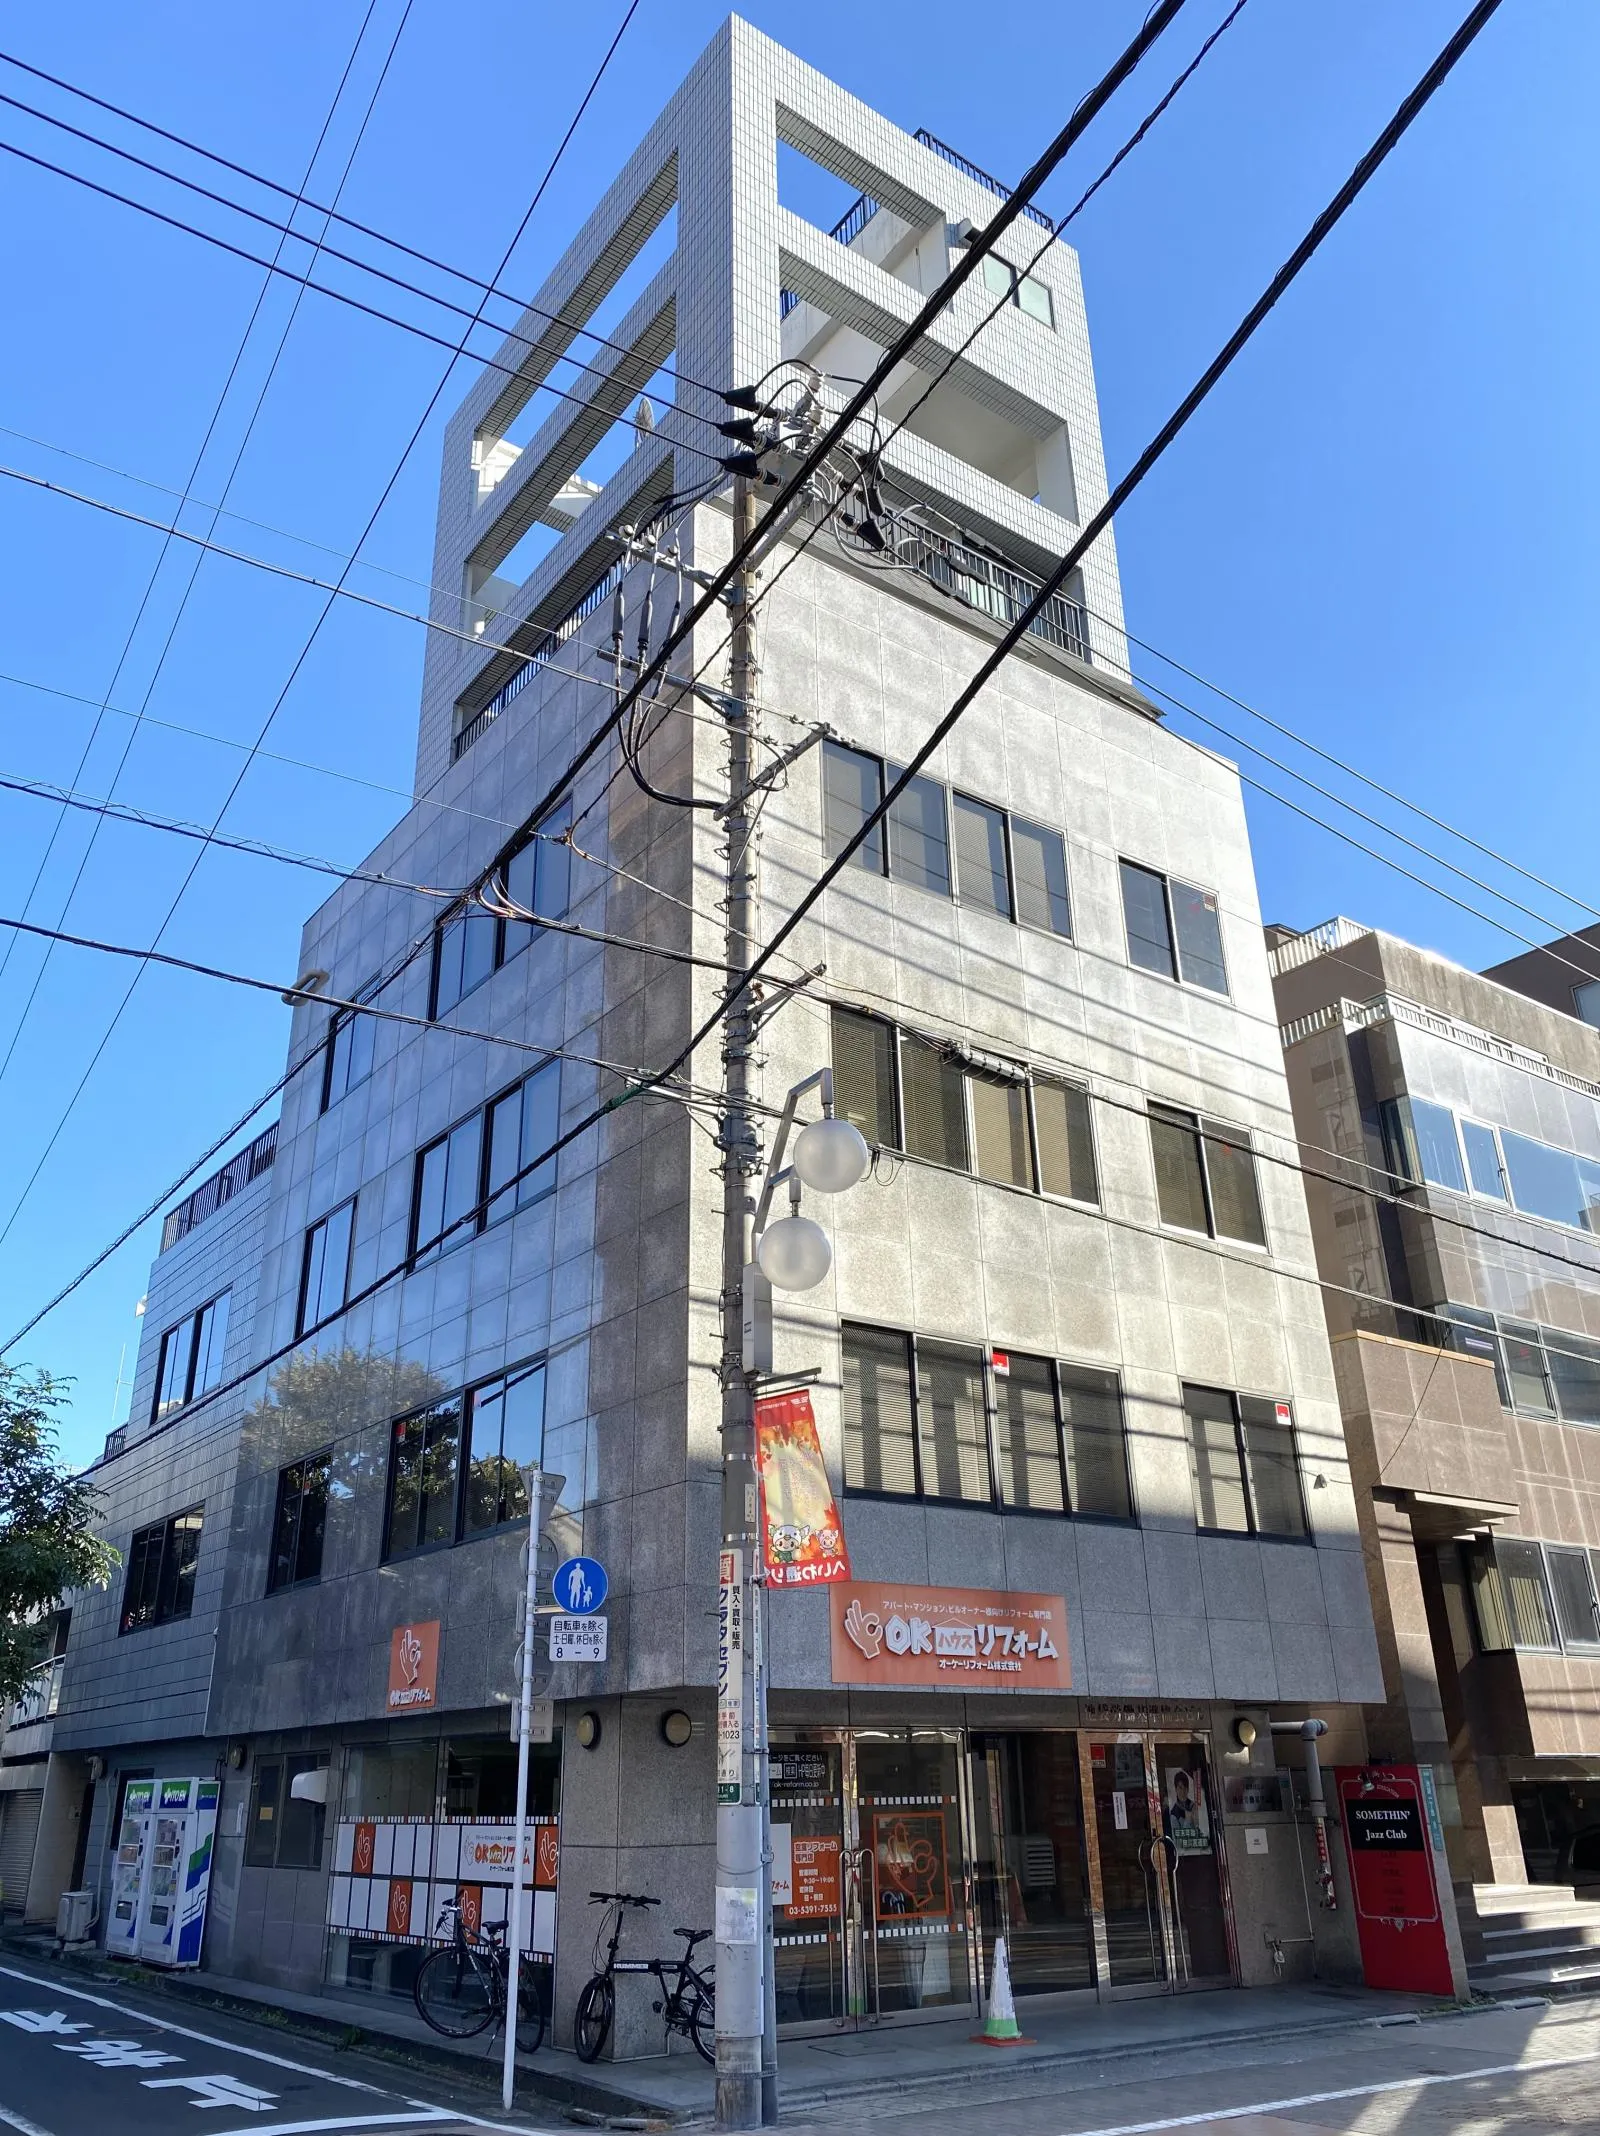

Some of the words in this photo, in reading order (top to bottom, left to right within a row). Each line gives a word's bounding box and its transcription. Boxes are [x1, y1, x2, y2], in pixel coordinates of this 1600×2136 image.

[554, 1620, 604, 1631] 自転車を除く
[556, 1648, 563, 1659] 8
[593, 1648, 600, 1659] 9
[939, 1658, 1022, 1672] オーケーリフォーム株式会社
[1355, 1809, 1411, 1820] SOMETHIN'
[1366, 1829, 1385, 1841] Jazz
[1386, 1829, 1408, 1839] Club
[789, 1904, 838, 1915] 03-5391-7555
